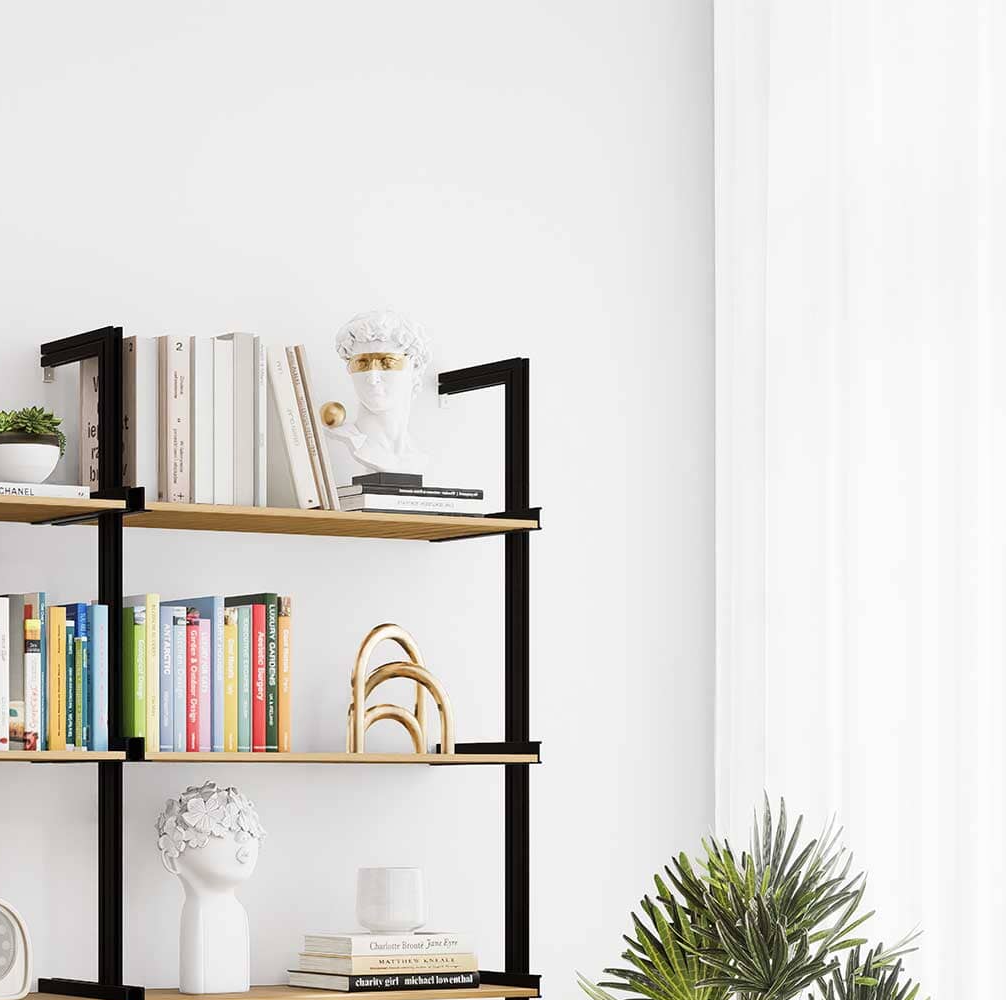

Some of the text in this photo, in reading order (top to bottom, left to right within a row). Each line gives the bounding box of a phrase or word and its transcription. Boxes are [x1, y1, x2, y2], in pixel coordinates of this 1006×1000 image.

[175, 341, 183, 351] 2
[268, 604, 276, 641] LUXURY
[163, 624, 171, 675] ANTARCTIC
[189, 629, 198, 657] Garden
[268, 642, 276, 686] GARDENS
[189, 665, 198, 697] Outdoor
[257, 667, 266, 701] Surgery
[188, 698, 197, 723] Design
[369, 940, 401, 951] Charlotte
[425, 938, 443, 949] Jane
[443, 938, 458, 948] Eyre
[355, 974, 473, 989] charity girl michael lowenthal
